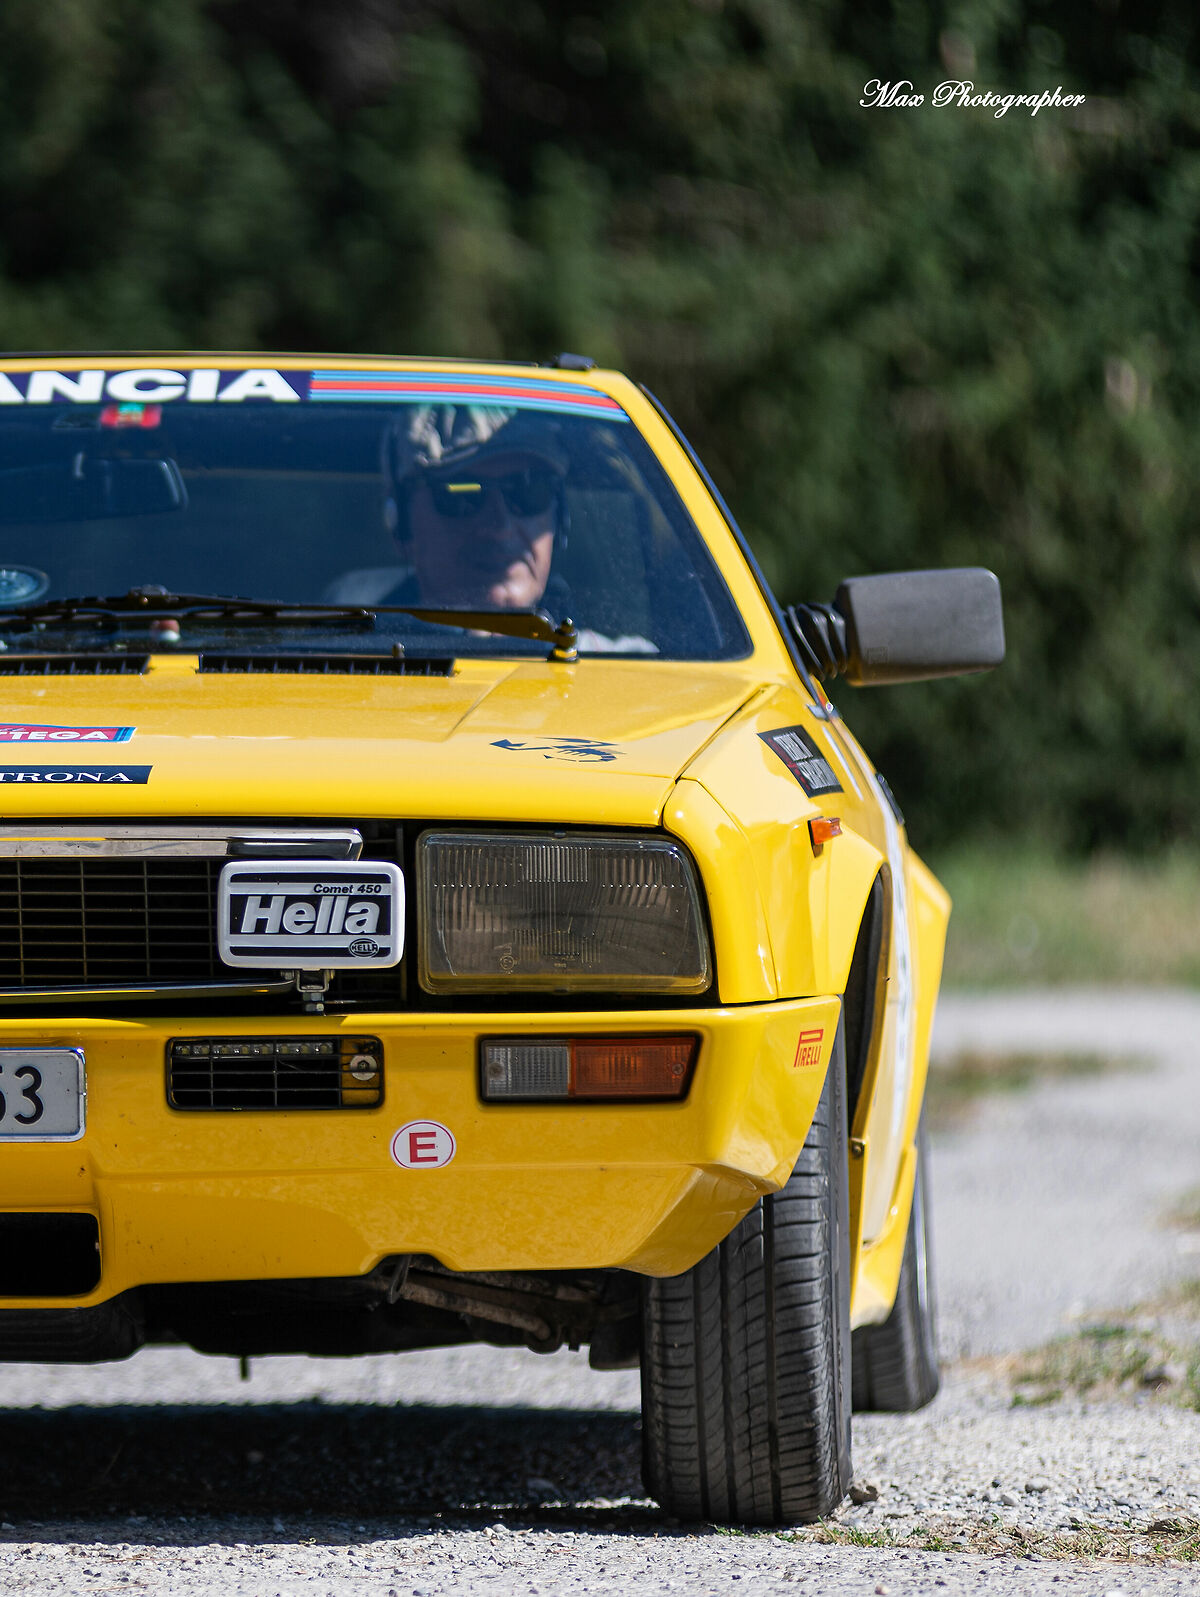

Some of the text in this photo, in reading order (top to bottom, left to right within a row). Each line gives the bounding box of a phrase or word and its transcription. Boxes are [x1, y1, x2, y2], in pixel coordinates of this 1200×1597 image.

[313, 884, 382, 894] Comet 450
[240, 895, 380, 935] Hella
[351, 942, 379, 952] HELLA
[793, 1028, 824, 1068] PIRELLI
[409, 1131, 439, 1163] E
